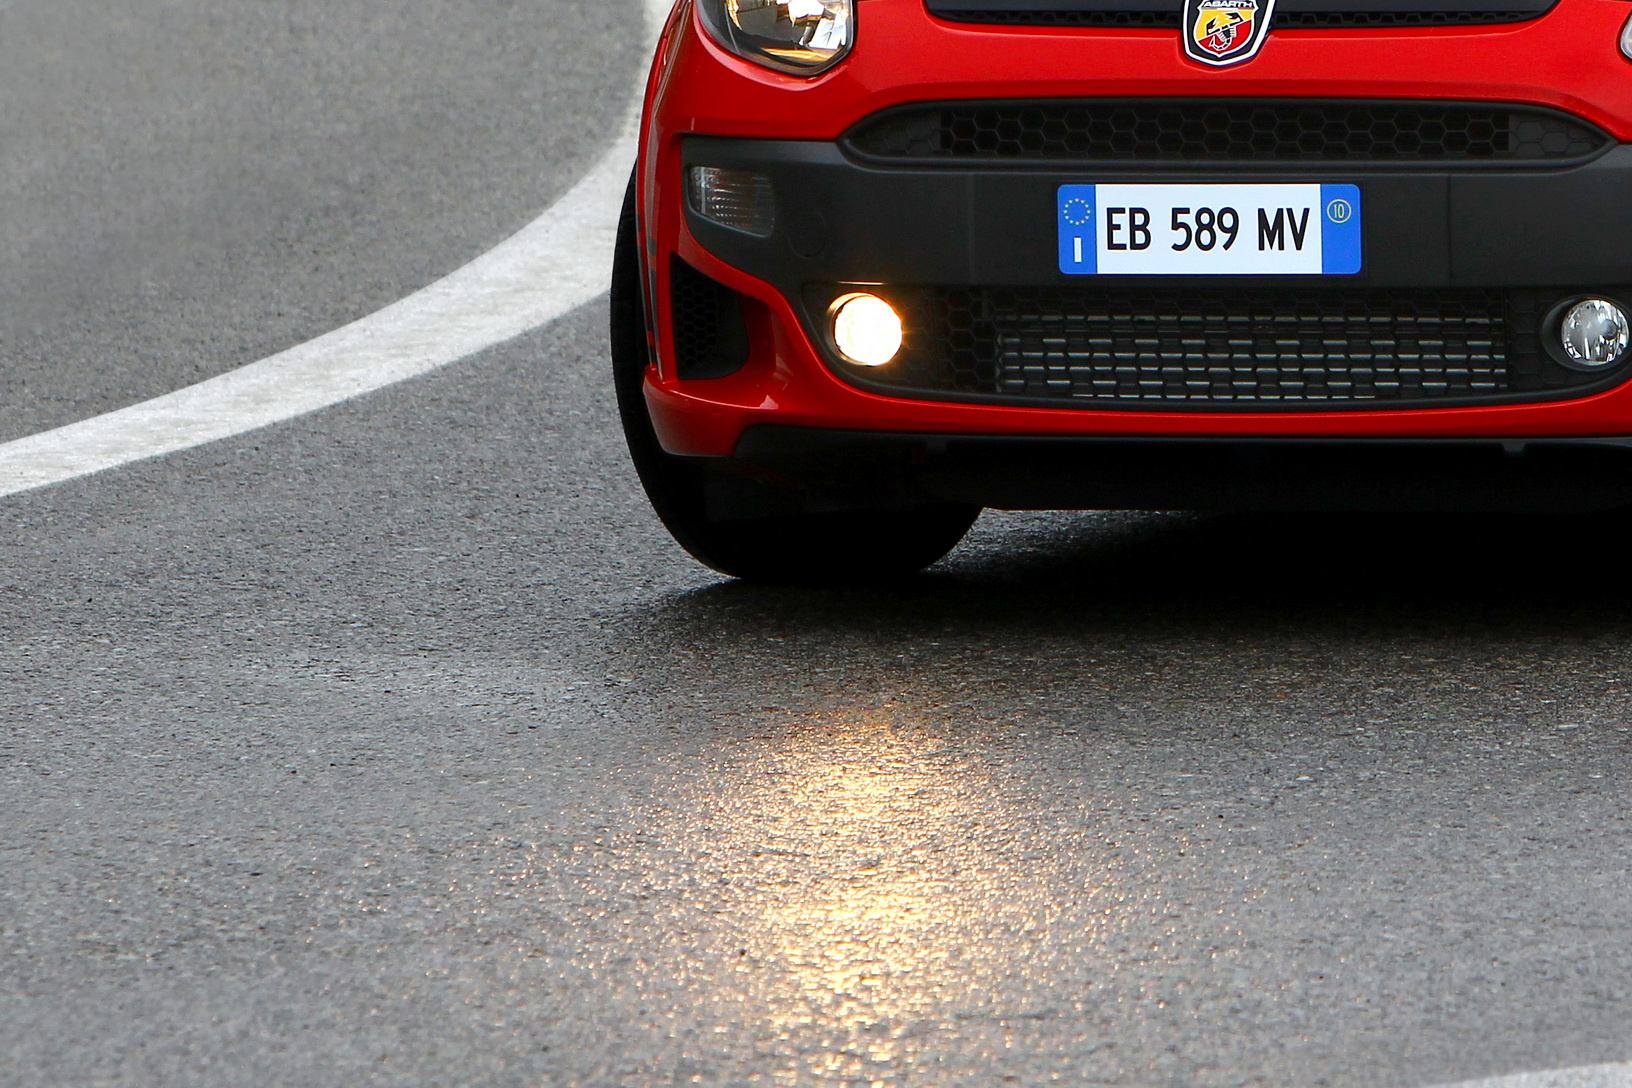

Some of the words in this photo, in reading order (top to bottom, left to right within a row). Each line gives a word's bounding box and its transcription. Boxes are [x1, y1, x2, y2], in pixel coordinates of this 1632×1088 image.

[1203, 0, 1253, 8] ABARTH
[1333, 203, 1345, 220] 10
[1106, 207, 1152, 251] EB
[1171, 207, 1240, 251] 589
[1258, 207, 1310, 251] MV
[1073, 236, 1083, 263] I
